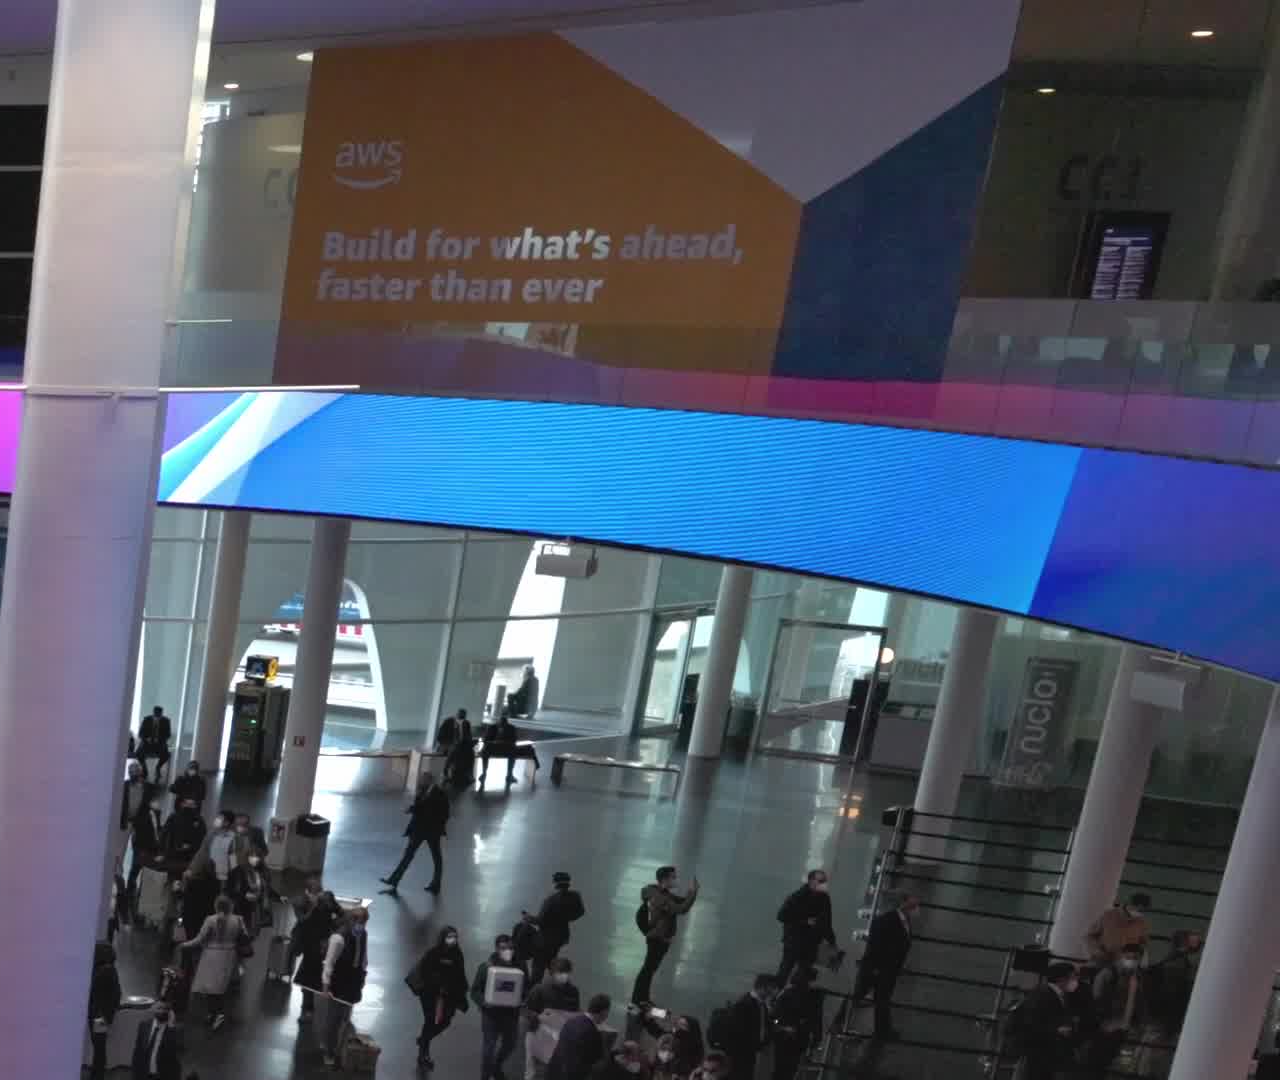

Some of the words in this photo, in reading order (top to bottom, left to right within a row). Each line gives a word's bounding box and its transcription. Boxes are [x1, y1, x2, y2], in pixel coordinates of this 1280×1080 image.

[334, 139, 403, 169] aws
[322, 229, 417, 261] Build
[425, 228, 481, 261] for
[490, 226, 612, 261] what's
[620, 223, 744, 264] ahead,
[316, 268, 422, 303] faster
[429, 270, 514, 303] than
[521, 277, 607, 303] ever
